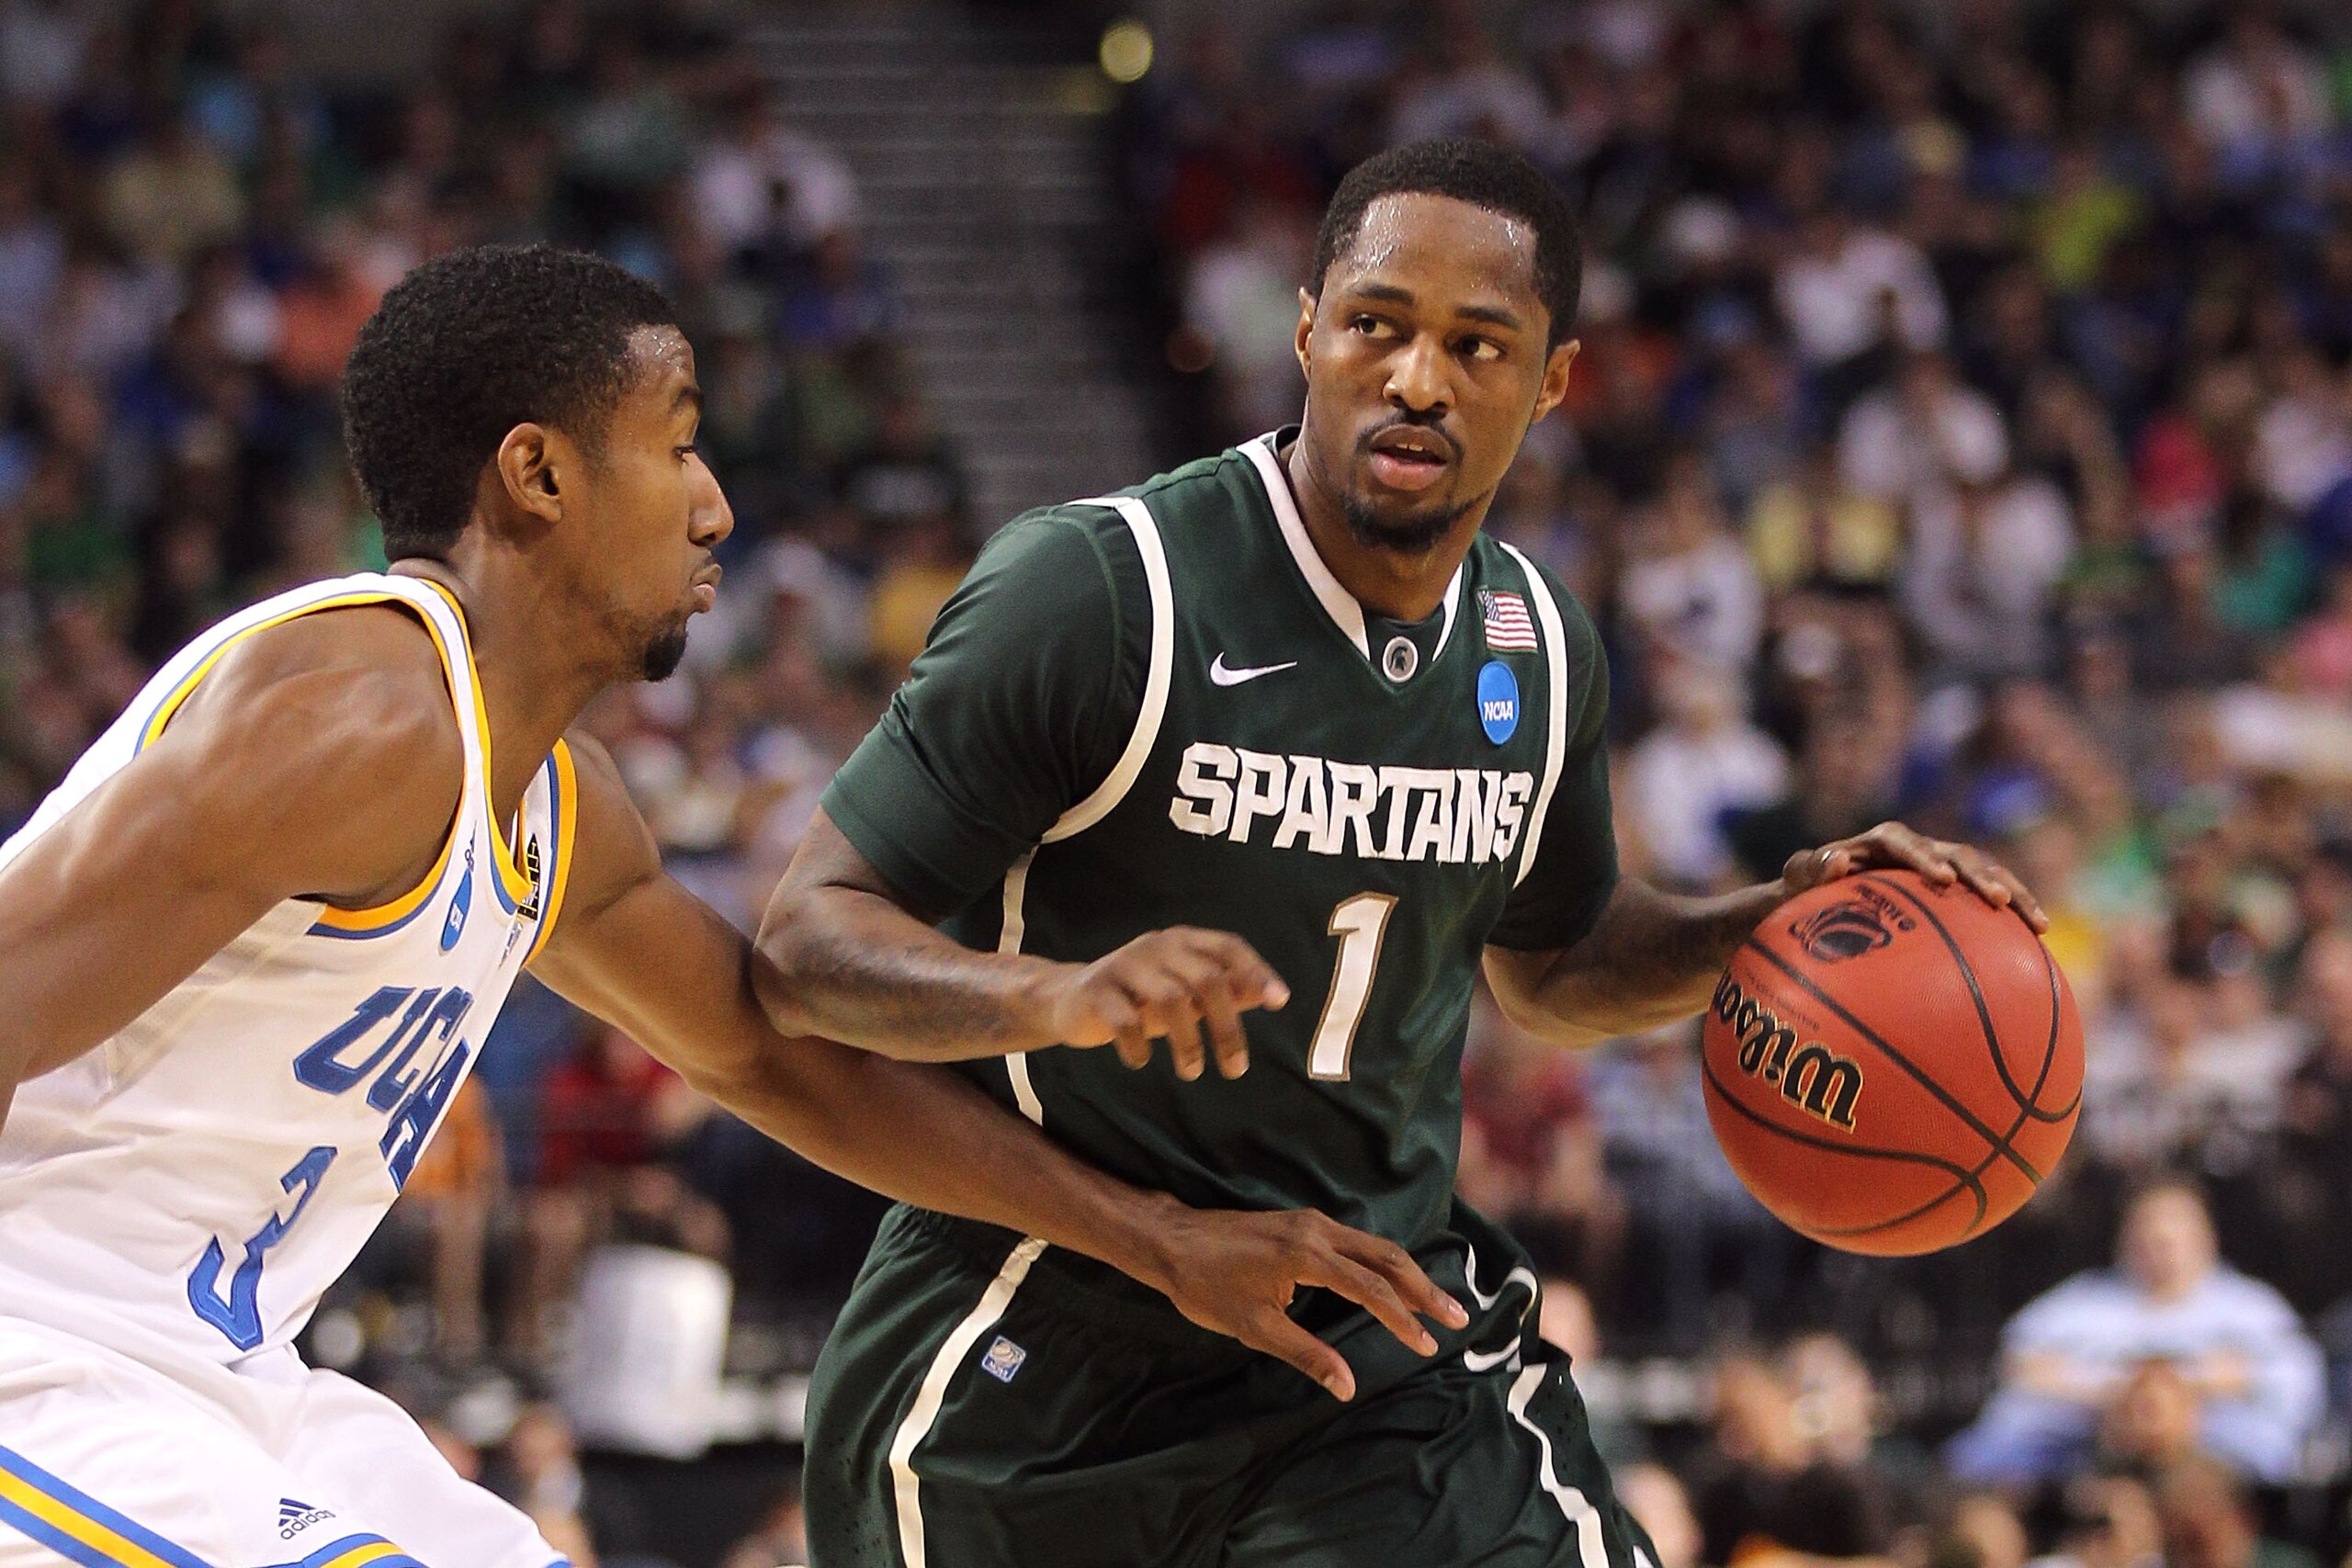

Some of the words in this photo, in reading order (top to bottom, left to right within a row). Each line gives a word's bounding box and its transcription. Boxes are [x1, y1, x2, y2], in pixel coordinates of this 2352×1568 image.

[1484, 700, 1514, 721] NCAA
[1169, 741, 1534, 863] SPARTANS
[1306, 890, 1399, 1082] 1
[187, 1145, 338, 1352] 3
[280, 1509, 336, 1540] adidas
